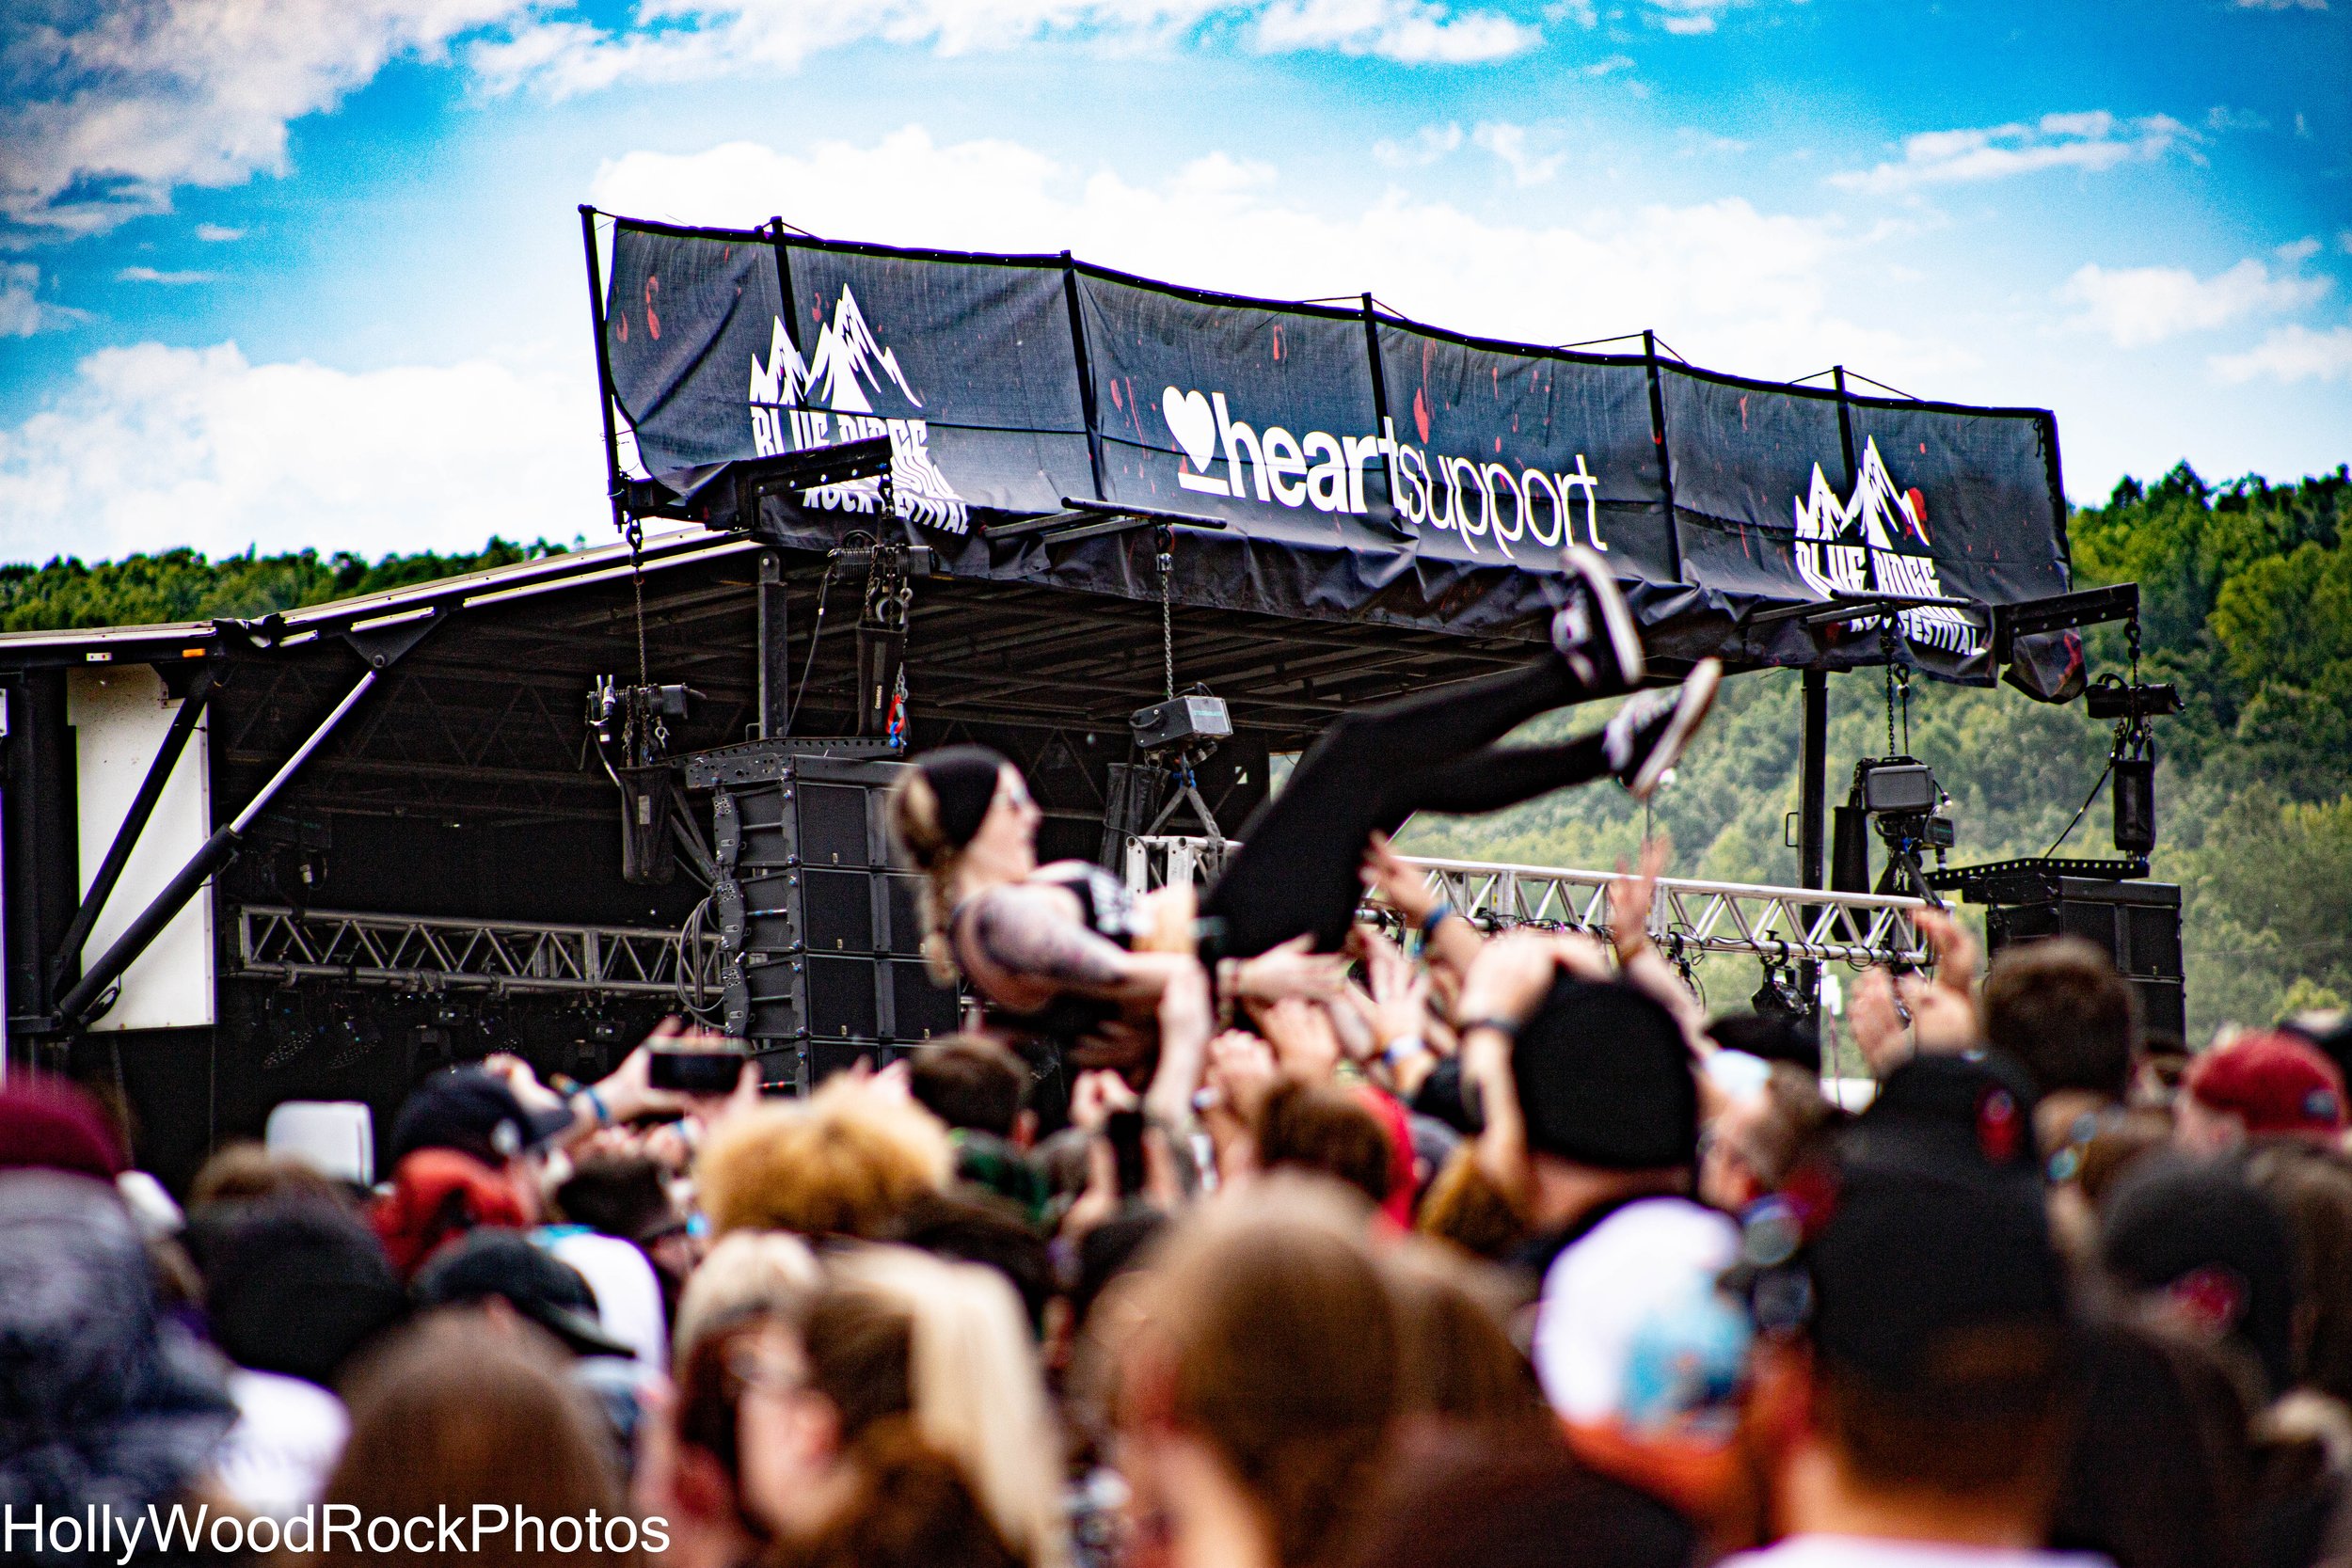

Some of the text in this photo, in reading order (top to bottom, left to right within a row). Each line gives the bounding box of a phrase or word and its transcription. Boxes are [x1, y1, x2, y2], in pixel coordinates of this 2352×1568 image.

[803, 486, 874, 514] ROCK
[1211, 391, 1608, 560] heartsupport
[1794, 541, 1867, 600] BLUE
[1901, 611, 1987, 657] FESTIVAL
